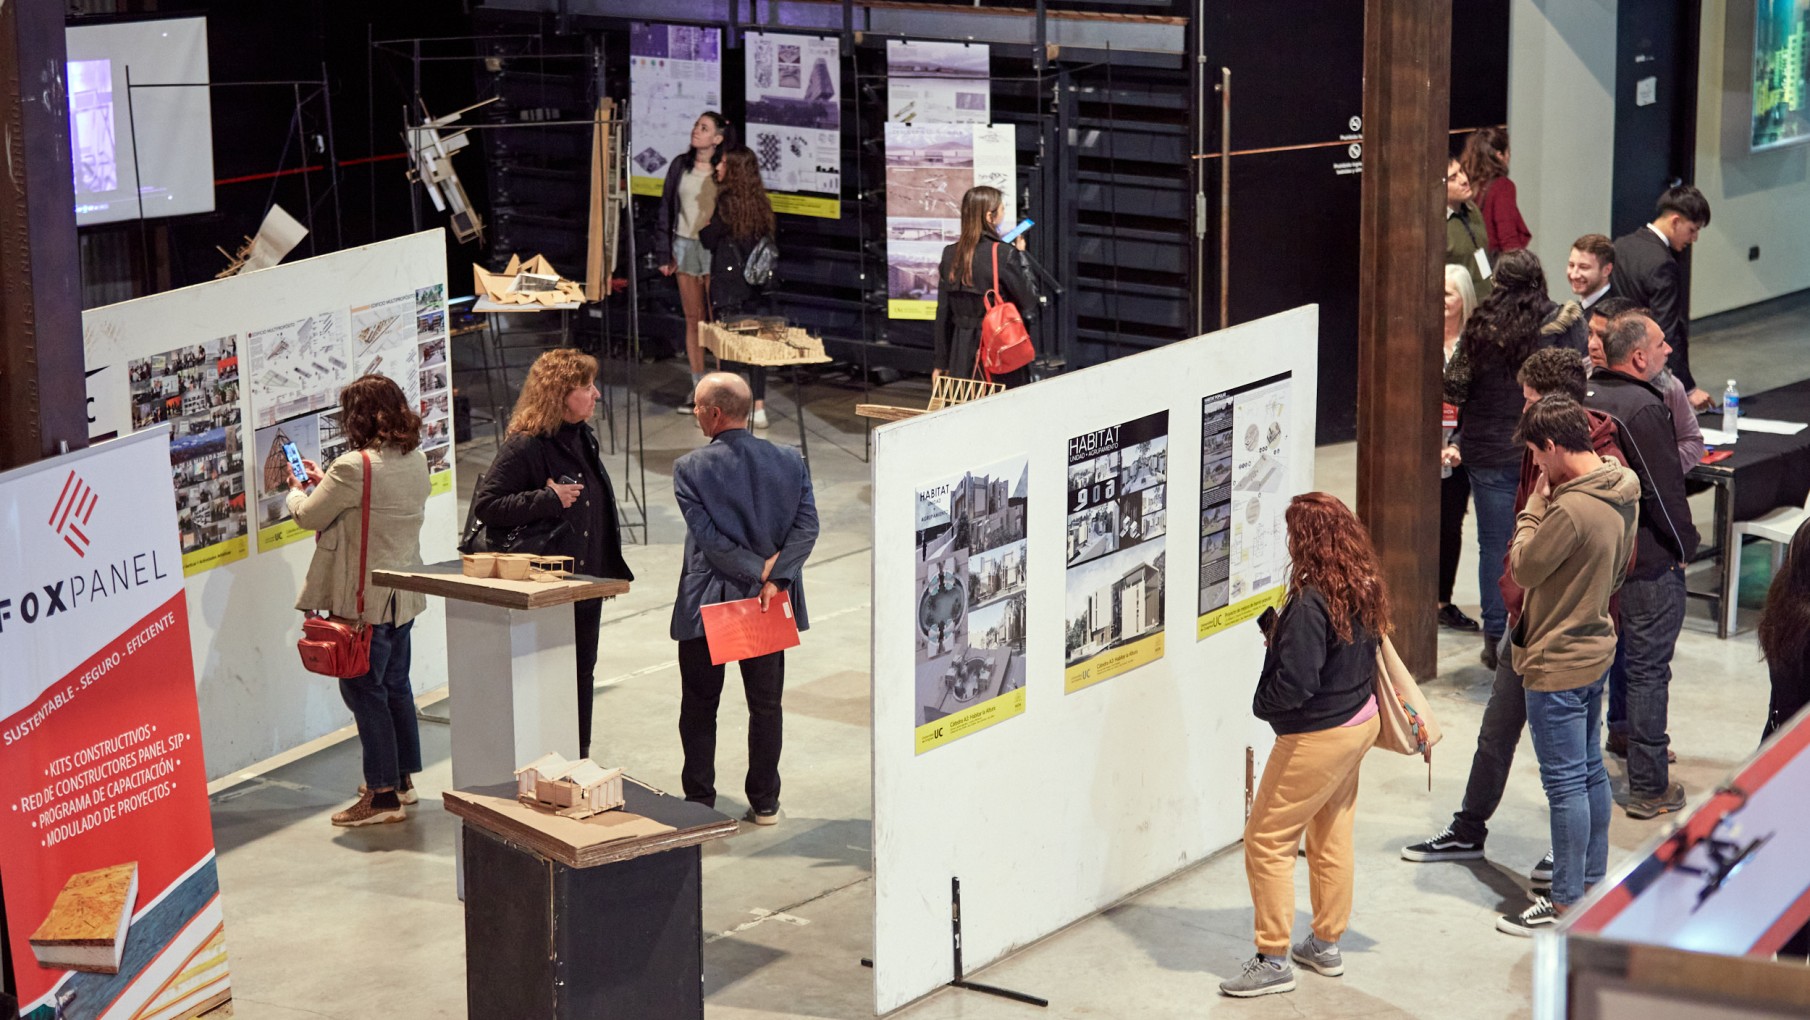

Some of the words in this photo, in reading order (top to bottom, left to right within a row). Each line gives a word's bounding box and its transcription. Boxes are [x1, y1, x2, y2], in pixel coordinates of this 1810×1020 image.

[1070, 425, 1122, 456] HABITAT
[1070, 453, 1086, 462] UNIDAD
[1088, 442, 1118, 456] AGRUPAMIENTO
[920, 484, 950, 502] HABITAT
[0, 550, 167, 633] FOXPANEL
[1212, 614, 1222, 628] UC
[4, 686, 74, 746] SUSTENTABLE
[80, 652, 120, 690] SEGURO
[126, 612, 175, 655] EFICIENTE
[1082, 669, 1090, 680] UC
[50, 756, 72, 777] KITS
[74, 724, 150, 768] CONSTRUCTIVOS
[934, 728, 944, 740] UC
[21, 788, 43, 813] RED
[44, 786, 54, 803] DE
[56, 751, 136, 798] CONSTRUCTORES
[138, 742, 167, 764] PANEL
[168, 733, 184, 752] SIP
[40, 794, 91, 829] PROGRAMA
[92, 788, 105, 804] DE
[106, 758, 174, 798] CAPACITACIÓN
[46, 811, 101, 848] MODULADO
[103, 804, 116, 822] DE
[118, 782, 170, 816] PROYECTOS
